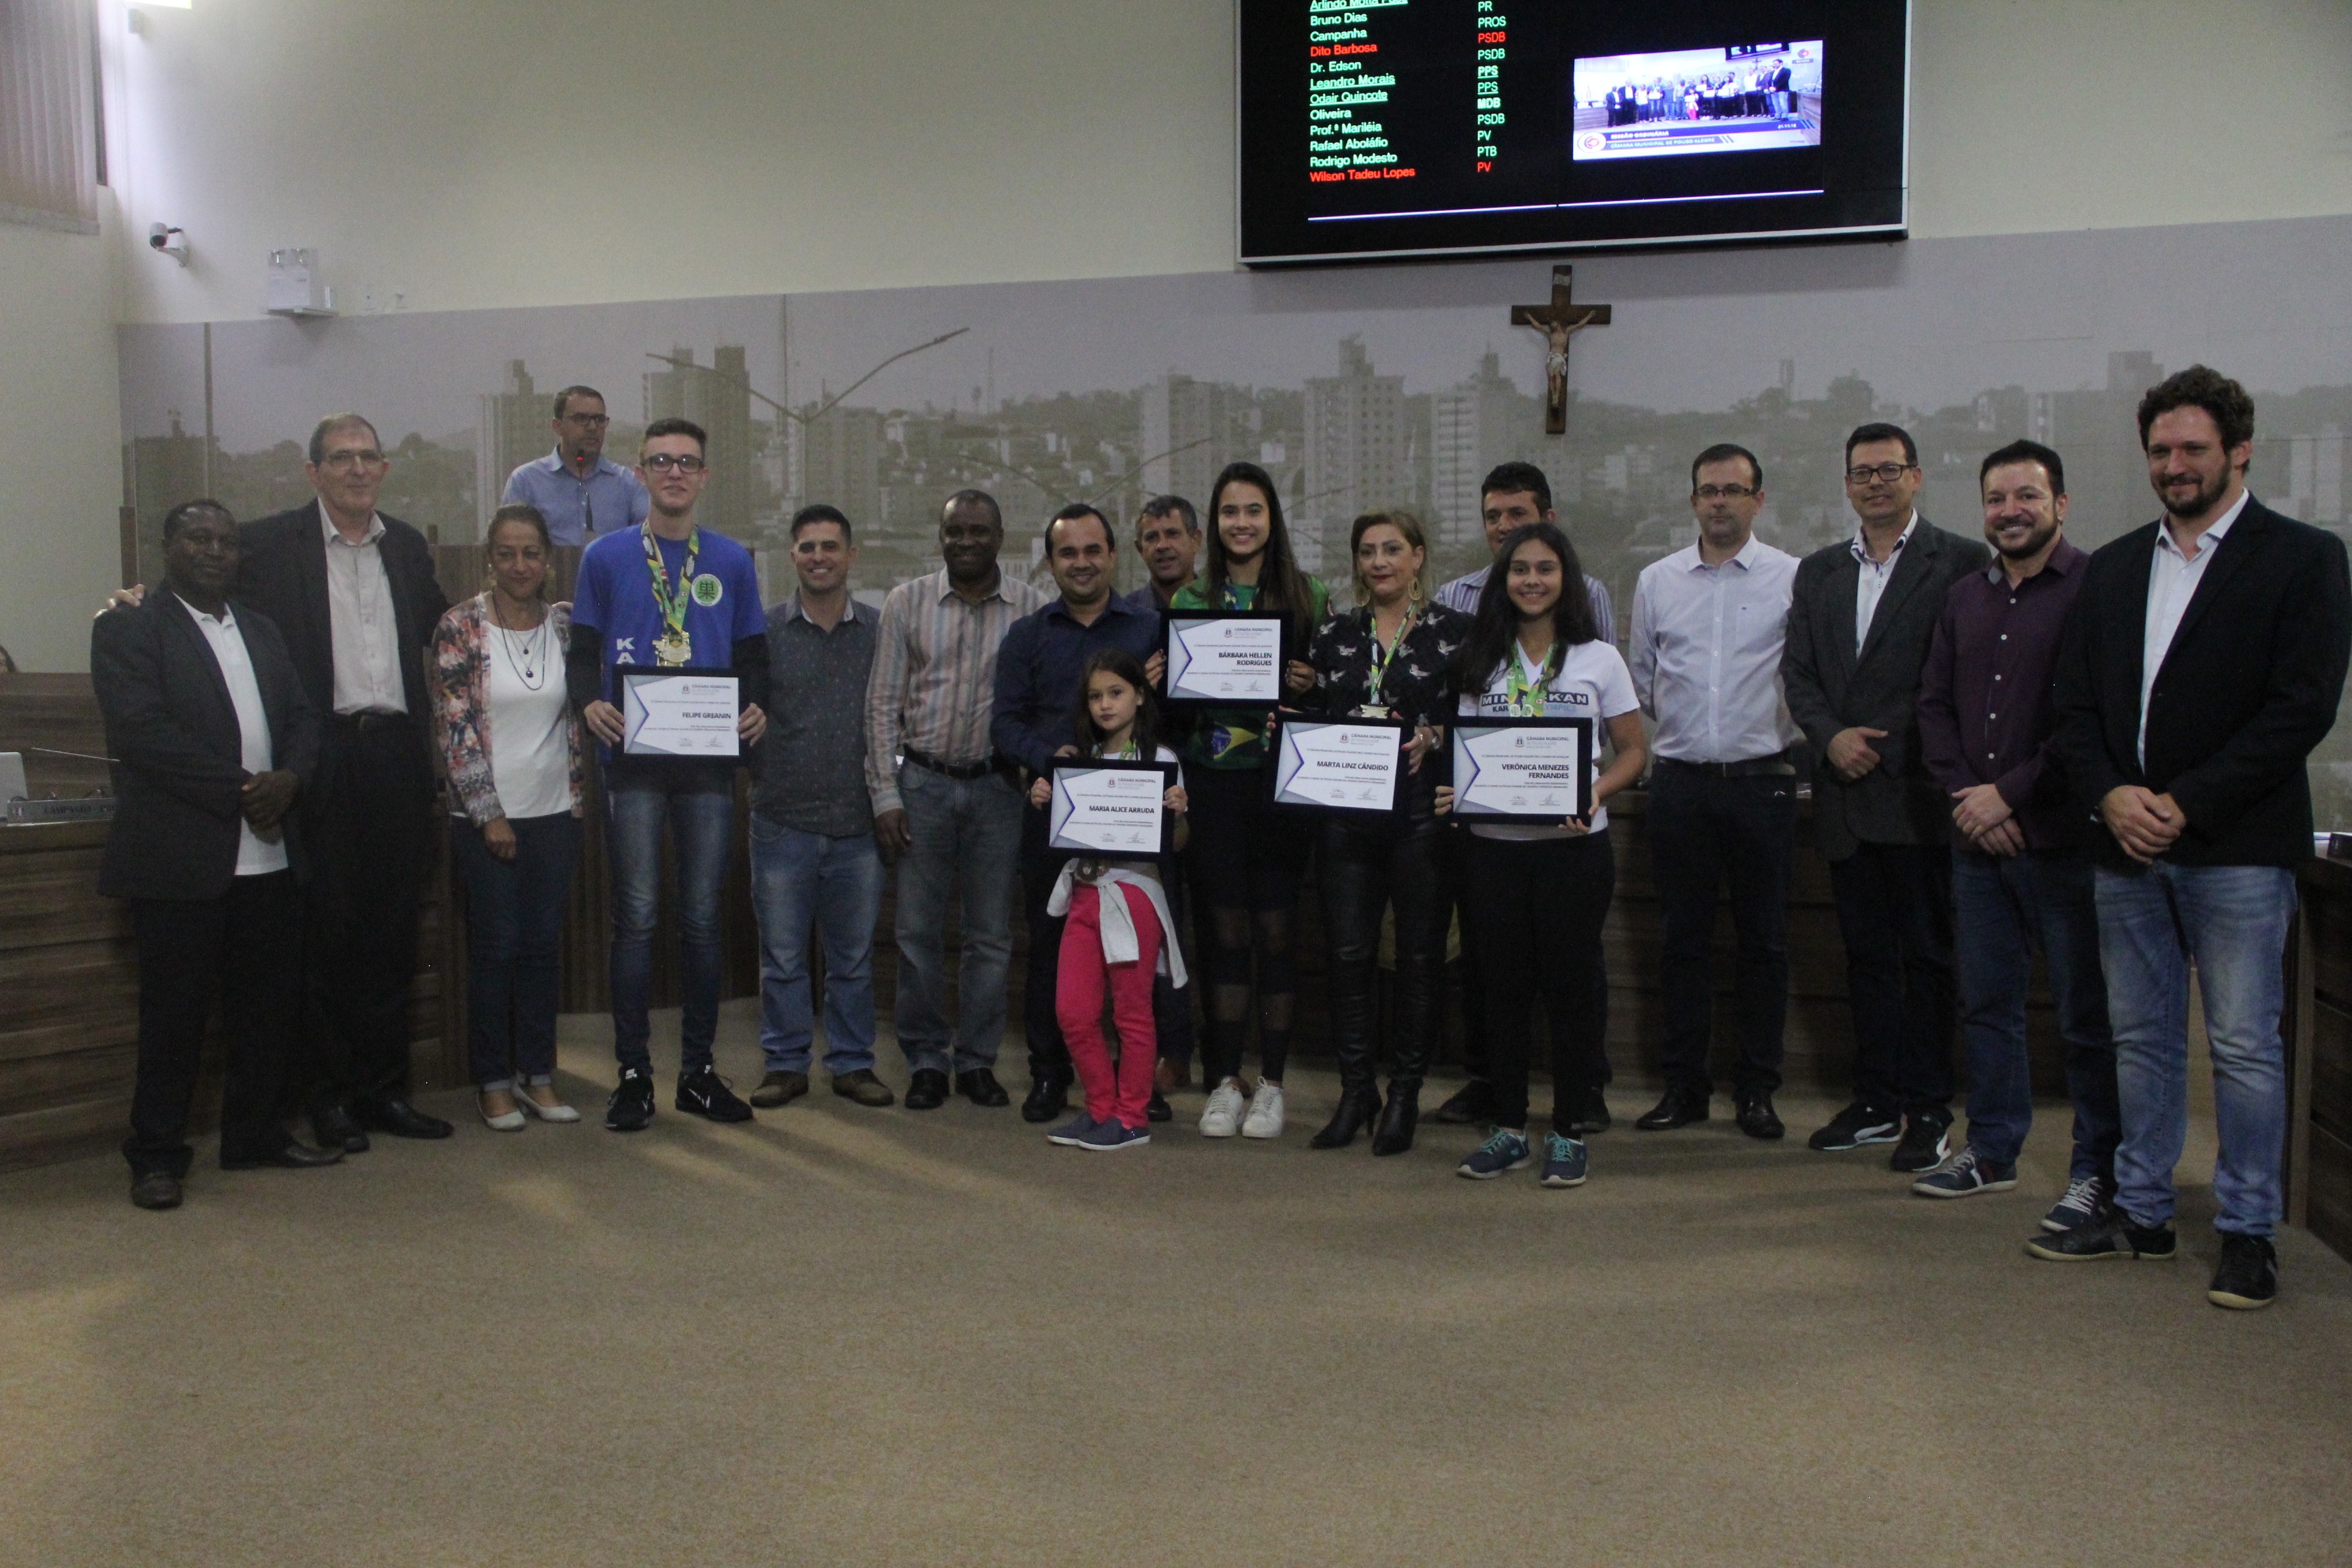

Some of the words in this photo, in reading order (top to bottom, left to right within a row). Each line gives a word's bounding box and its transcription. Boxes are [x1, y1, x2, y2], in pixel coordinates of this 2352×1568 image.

[1477, 1, 1492, 12] PR
[1310, 15, 1341, 26] Bruno
[1344, 12, 1367, 23] Dias
[1477, 16, 1507, 28] PROS
[1310, 28, 1367, 42] Campanha
[1477, 31, 1505, 43] PSDB
[1310, 45, 1330, 56] Dito
[1334, 43, 1377, 54] Barbosa
[1477, 48, 1505, 60] PSDB
[1310, 63, 1325, 73] Dr.
[1329, 61, 1361, 72] Edson
[1477, 65, 1498, 76] PPS
[1310, 76, 1355, 88] Leandro
[1358, 73, 1395, 85] Morais
[1477, 82, 1498, 93] PPS
[1310, 93, 1339, 105] Odair
[1341, 90, 1388, 102] Quincote
[1477, 97, 1501, 109] MDB
[1310, 108, 1352, 120] Oliveira
[1477, 113, 1505, 125] PSDB
[1342, 122, 1382, 133] Mariléia
[1477, 130, 1492, 141] PV
[1310, 140, 1343, 152] Rafael
[1345, 137, 1388, 150] Aboláfio
[1477, 146, 1497, 157] PTB
[1310, 155, 1350, 167] Rodrigo
[1353, 152, 1397, 165] Modesto
[1477, 161, 1491, 172] PV
[1309, 172, 1345, 182] Wilson
[1348, 169, 1380, 180] Tadeu
[1384, 167, 1416, 178] Lopes
[1358, 762, 1388, 770] CÂNDIDO
